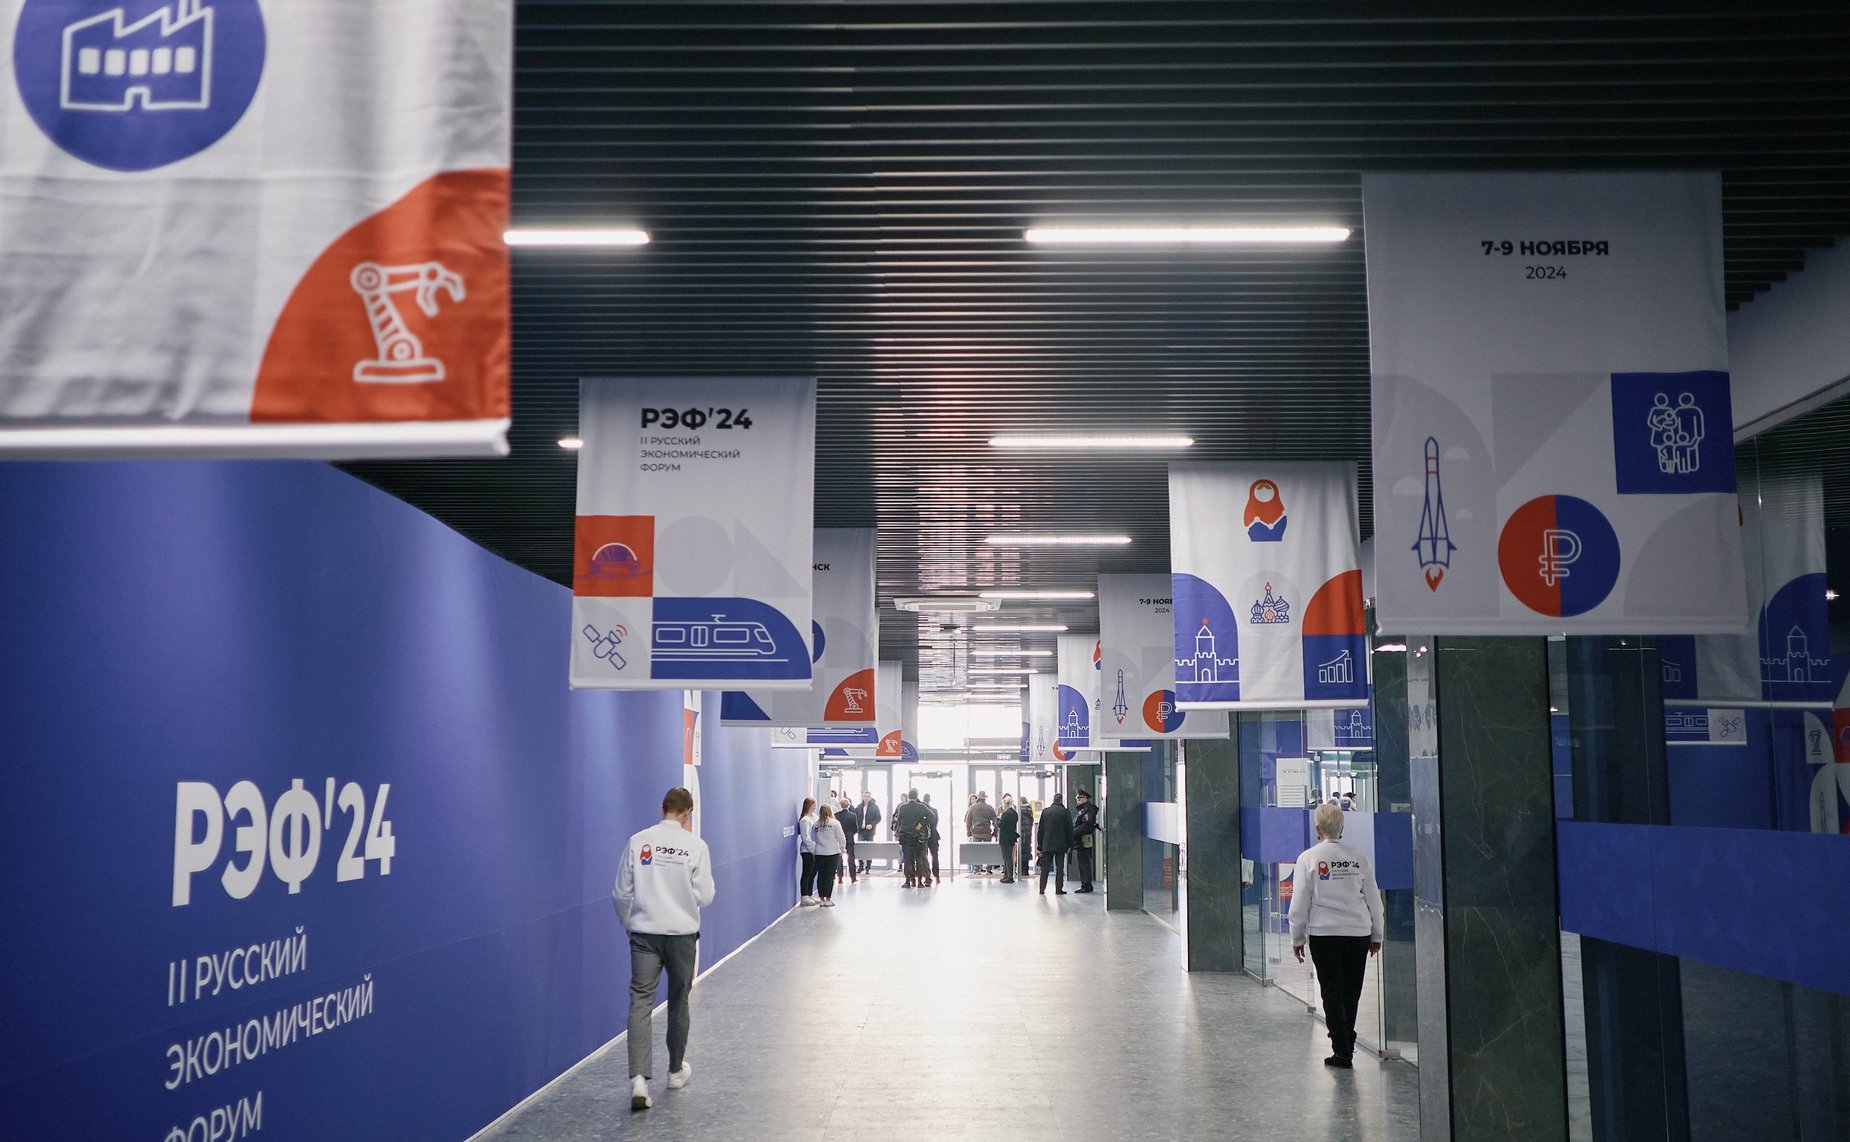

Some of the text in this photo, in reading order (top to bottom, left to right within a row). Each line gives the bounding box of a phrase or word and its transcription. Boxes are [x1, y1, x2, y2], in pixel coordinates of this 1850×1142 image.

[1481, 240, 1609, 256] 7-9 НОЯБРЯ
[1525, 266, 1567, 279] 2024
[641, 408, 752, 430] РЭФ'24
[650, 436, 701, 446] РУССКИЙ
[640, 449, 741, 459] ЭКОНОМИЧЕСКИЙ
[640, 463, 681, 472] ФОРУМ
[171, 776, 396, 908] РЭФ'24
[194, 925, 308, 1000] РУССКИЙ
[164, 972, 375, 1091] ЭКОНОМИЧЕСКИЙ
